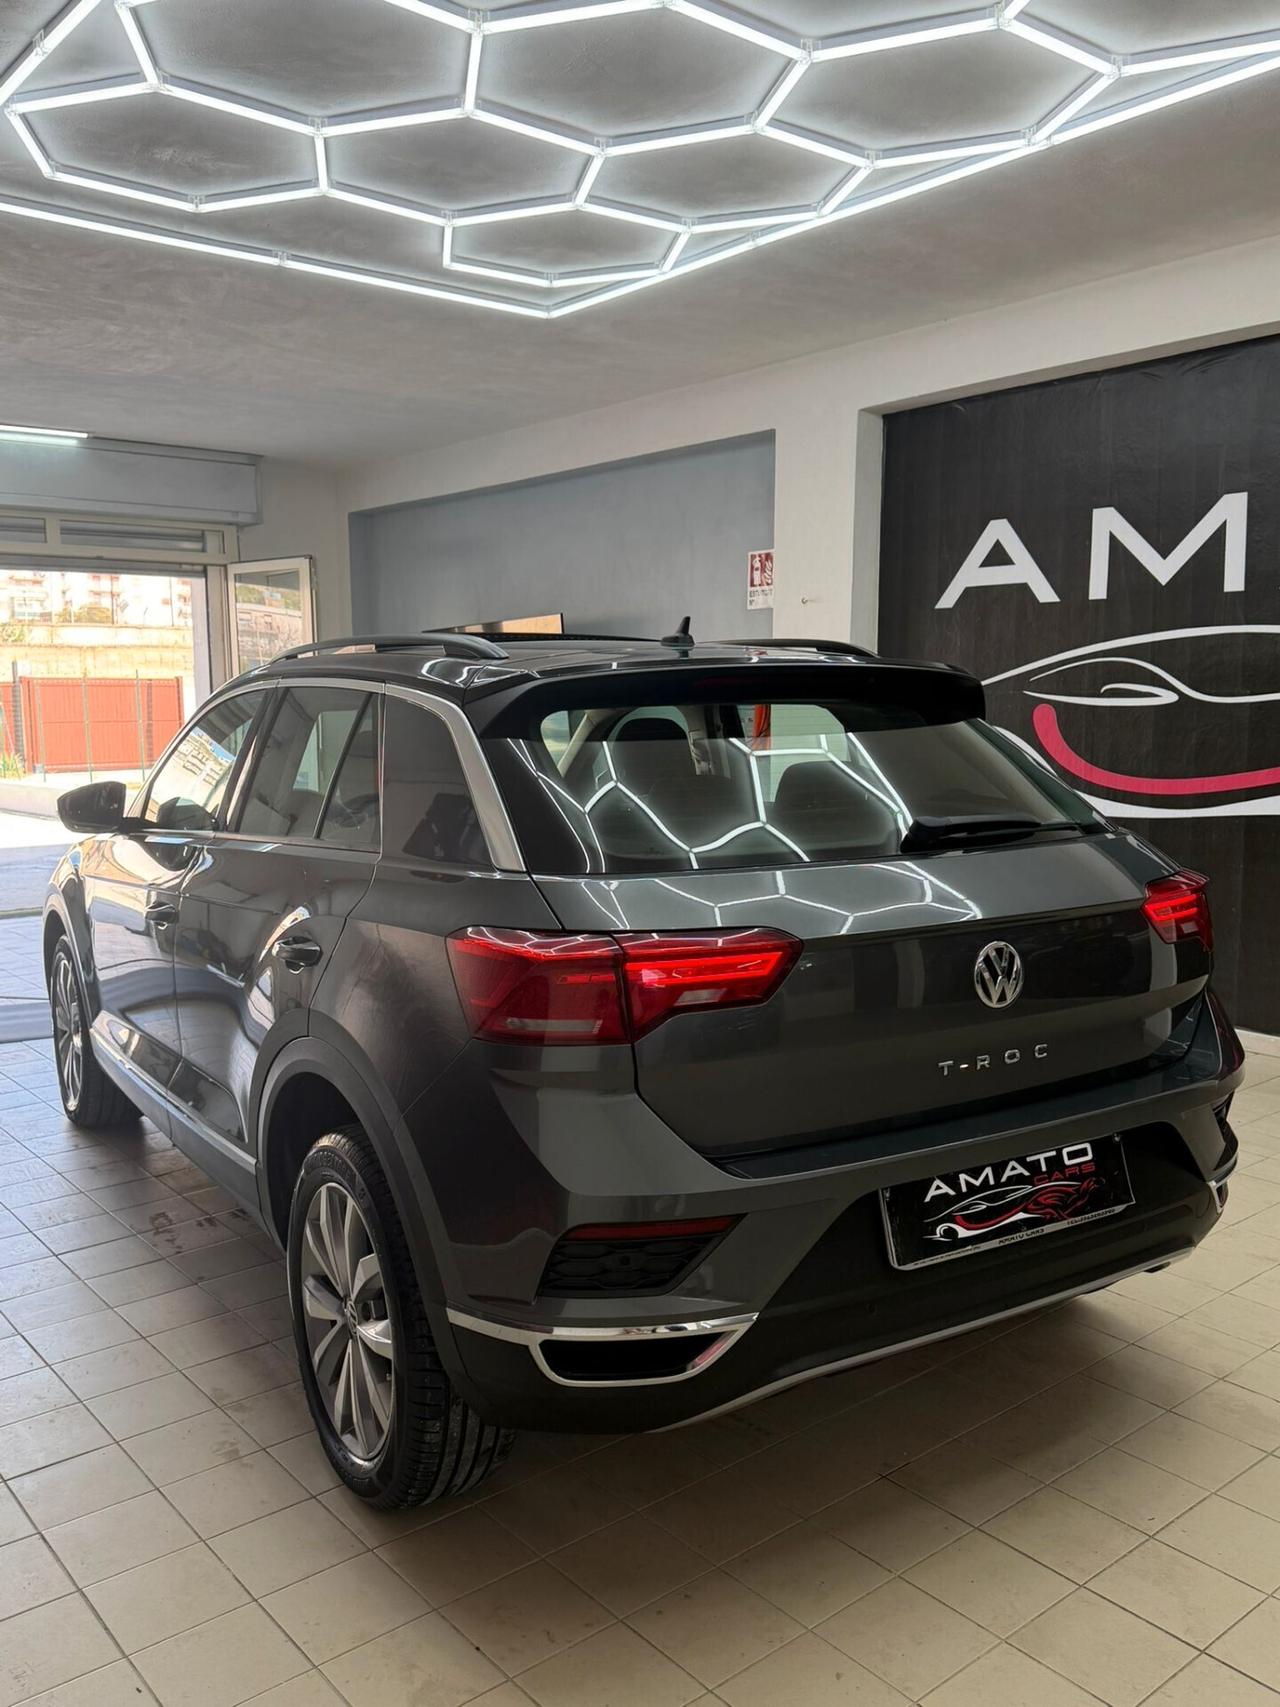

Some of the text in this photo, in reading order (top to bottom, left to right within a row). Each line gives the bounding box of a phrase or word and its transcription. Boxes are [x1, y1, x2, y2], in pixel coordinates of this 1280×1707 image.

[938, 1044, 1048, 1076] T-ROC
[924, 1142, 1093, 1203] AMATO
[1033, 1163, 1096, 1185] CARS
